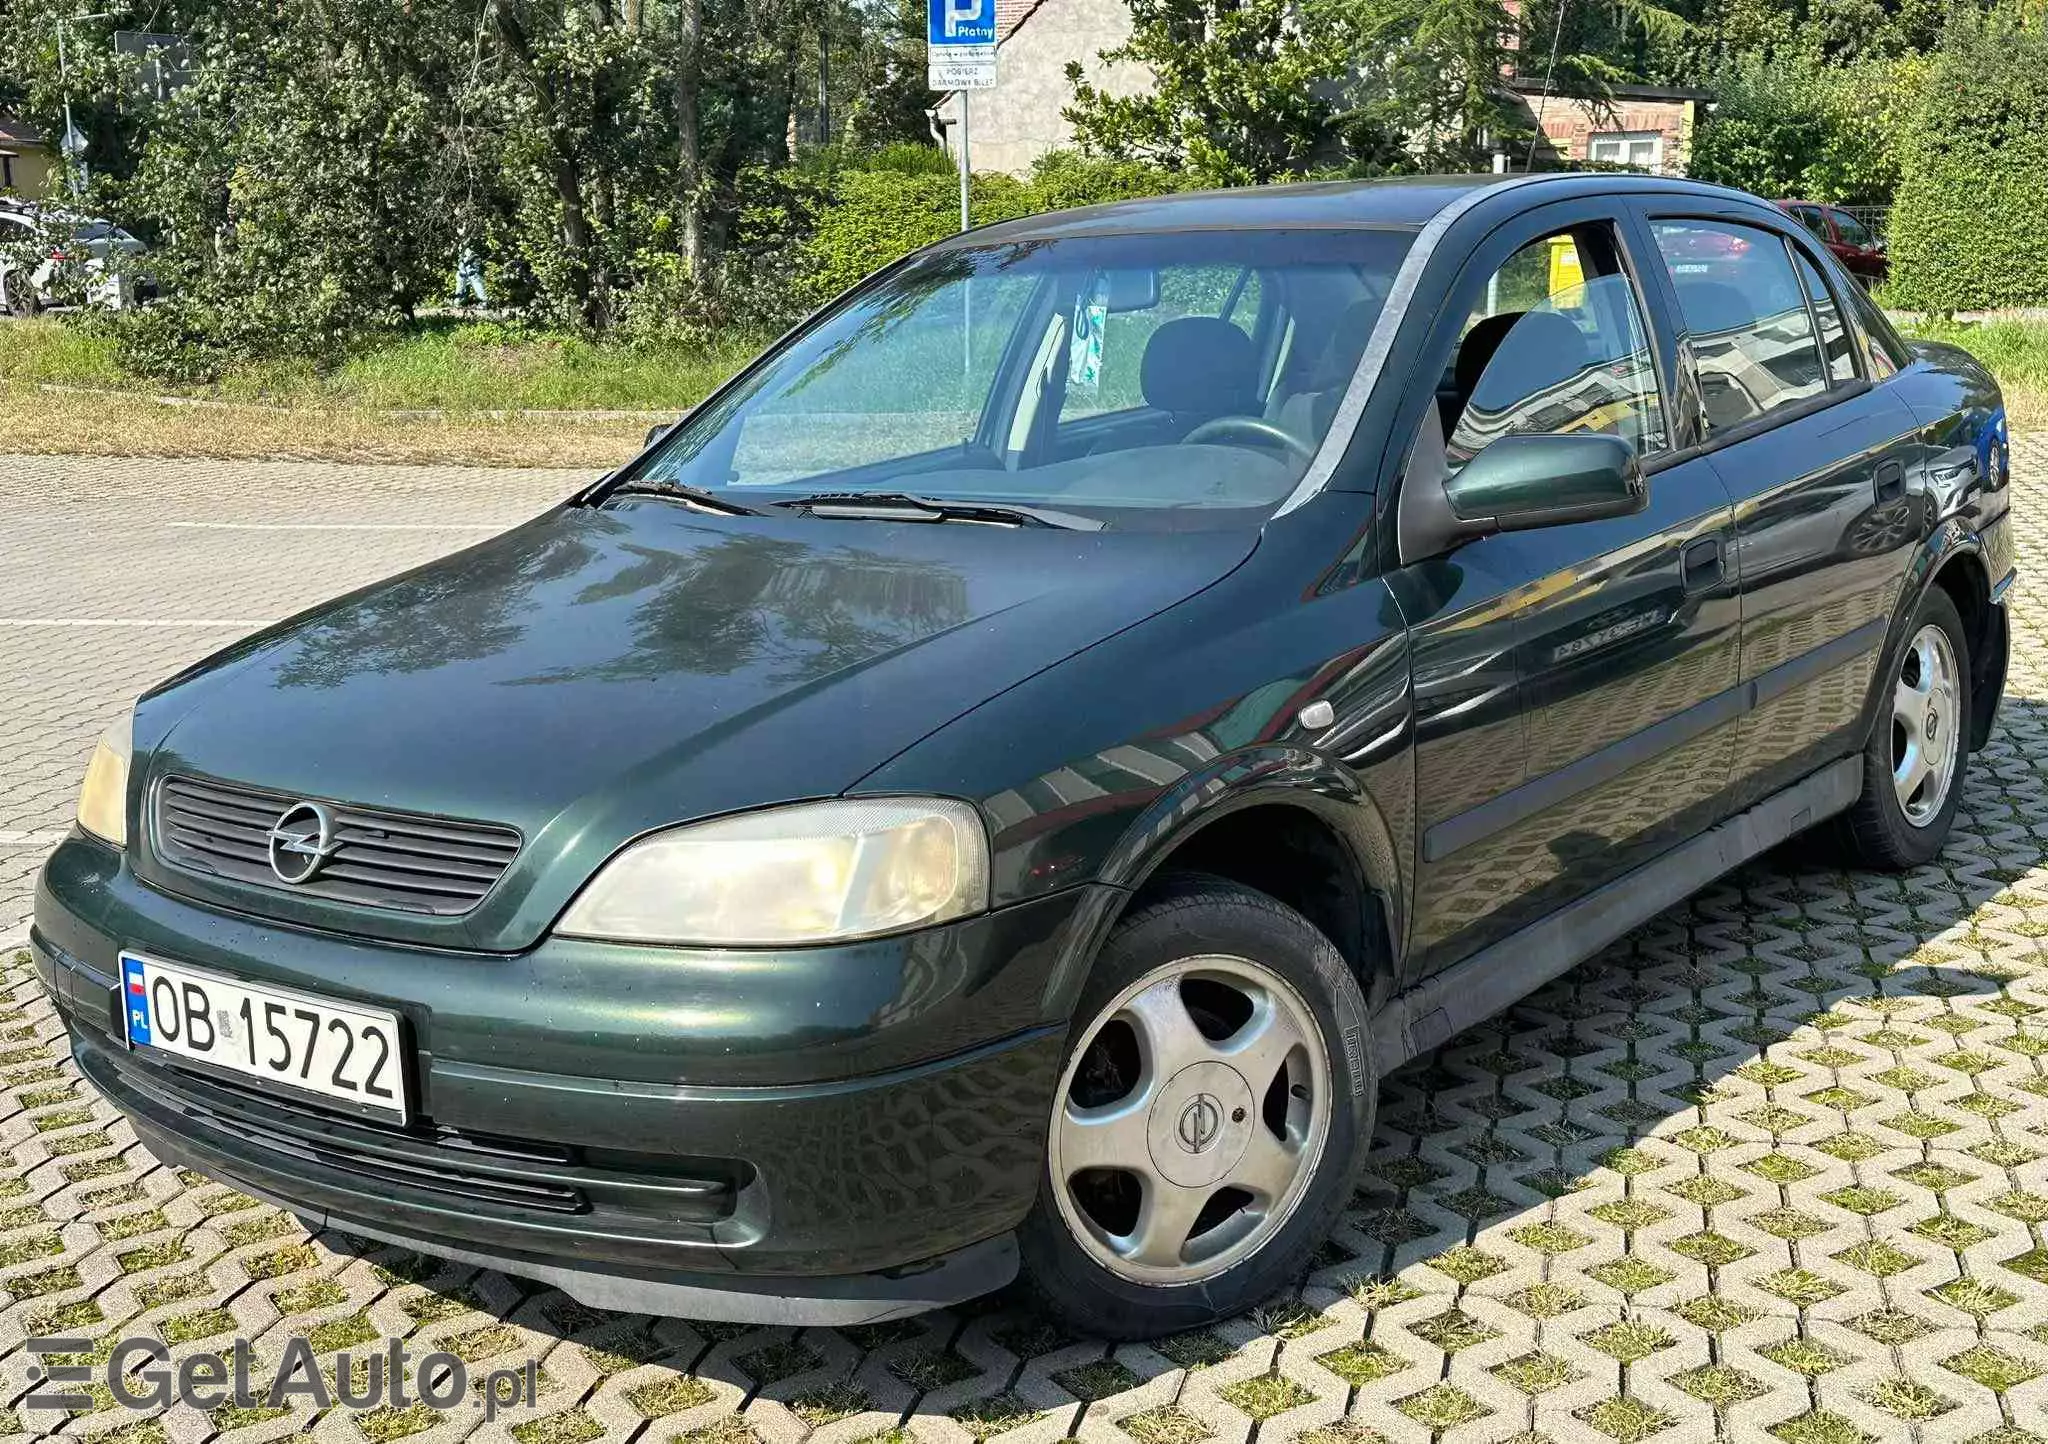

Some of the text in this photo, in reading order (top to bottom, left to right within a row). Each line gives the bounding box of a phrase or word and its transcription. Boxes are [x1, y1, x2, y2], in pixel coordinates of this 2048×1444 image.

[945, 0, 982, 37] P
[132, 1009, 149, 1030] PL
[152, 975, 393, 1100] OB 15722
